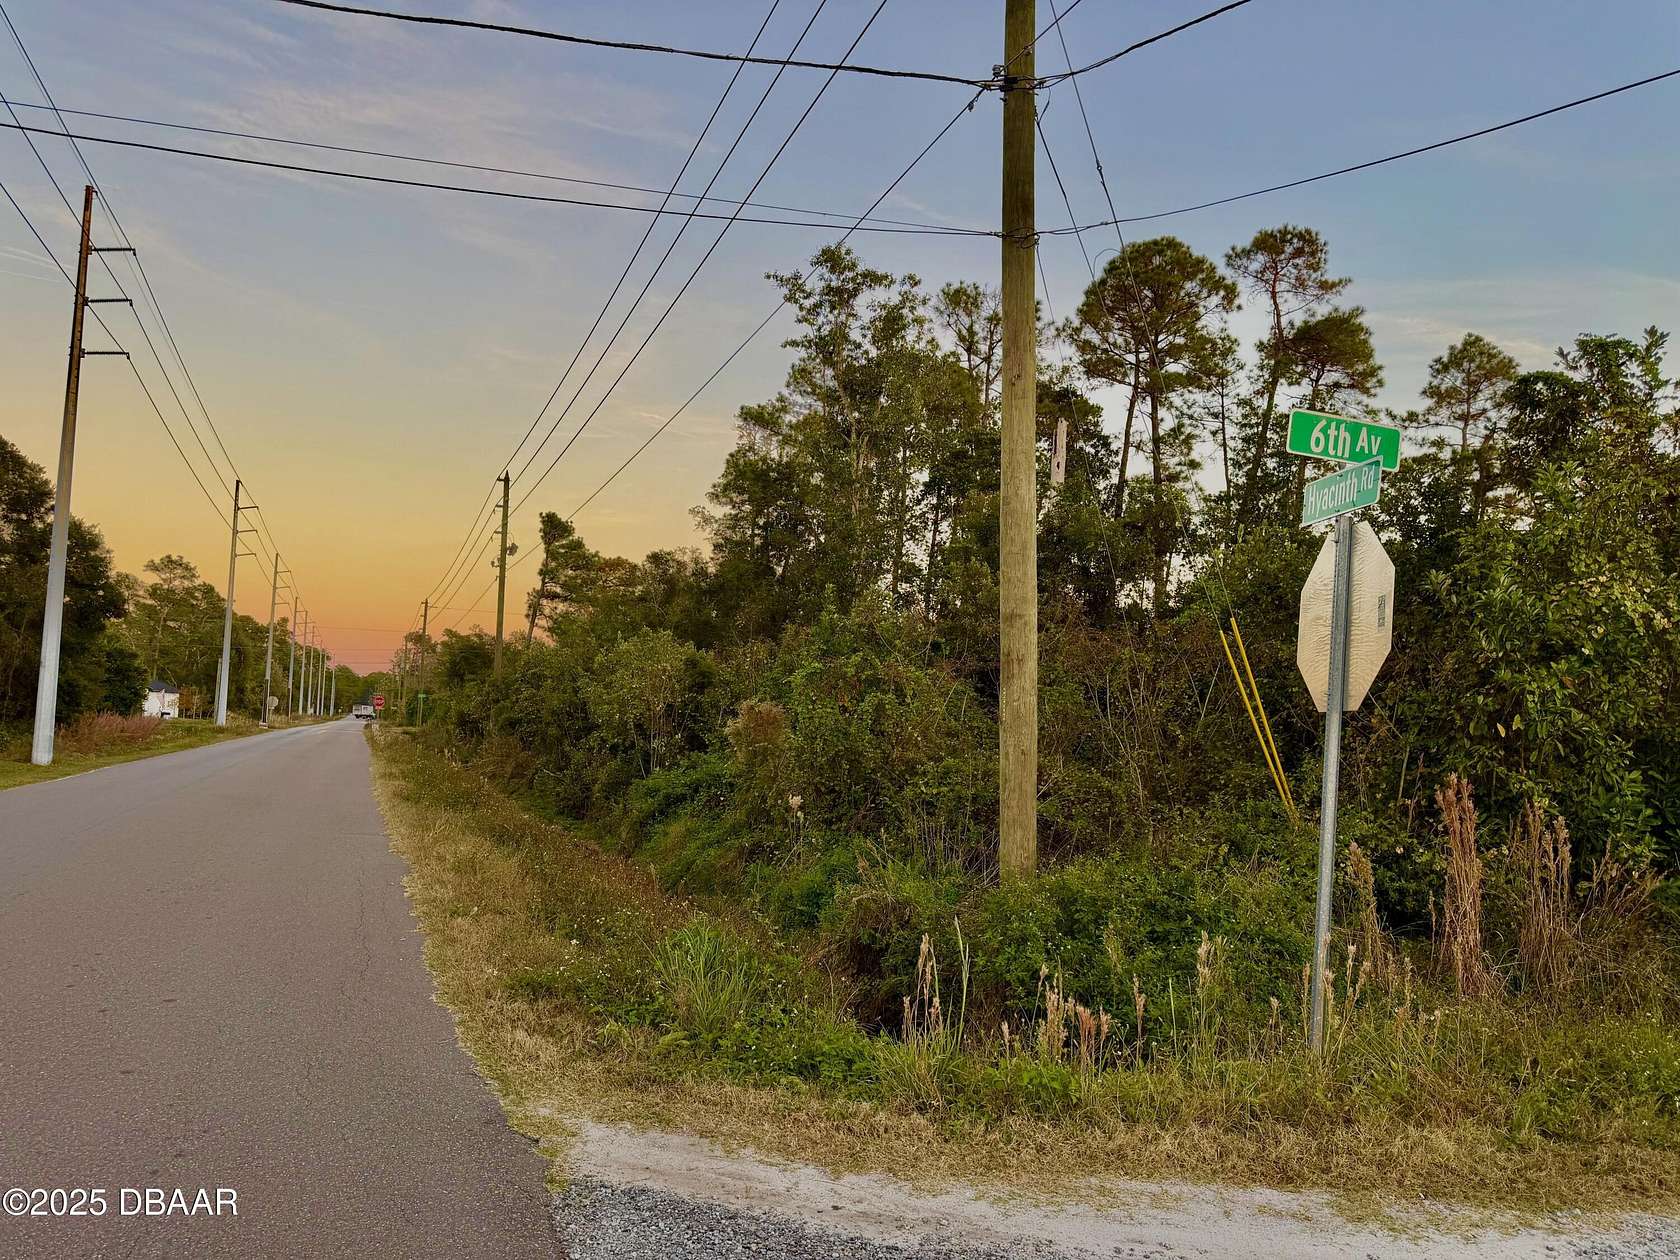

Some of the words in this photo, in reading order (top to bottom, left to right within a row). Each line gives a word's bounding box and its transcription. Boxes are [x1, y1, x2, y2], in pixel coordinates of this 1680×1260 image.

[1310, 419, 1351, 458] 6th
[1356, 427, 1382, 456] Av
[1307, 471, 1358, 518] Hyacinth
[1360, 464, 1376, 492] Rd
